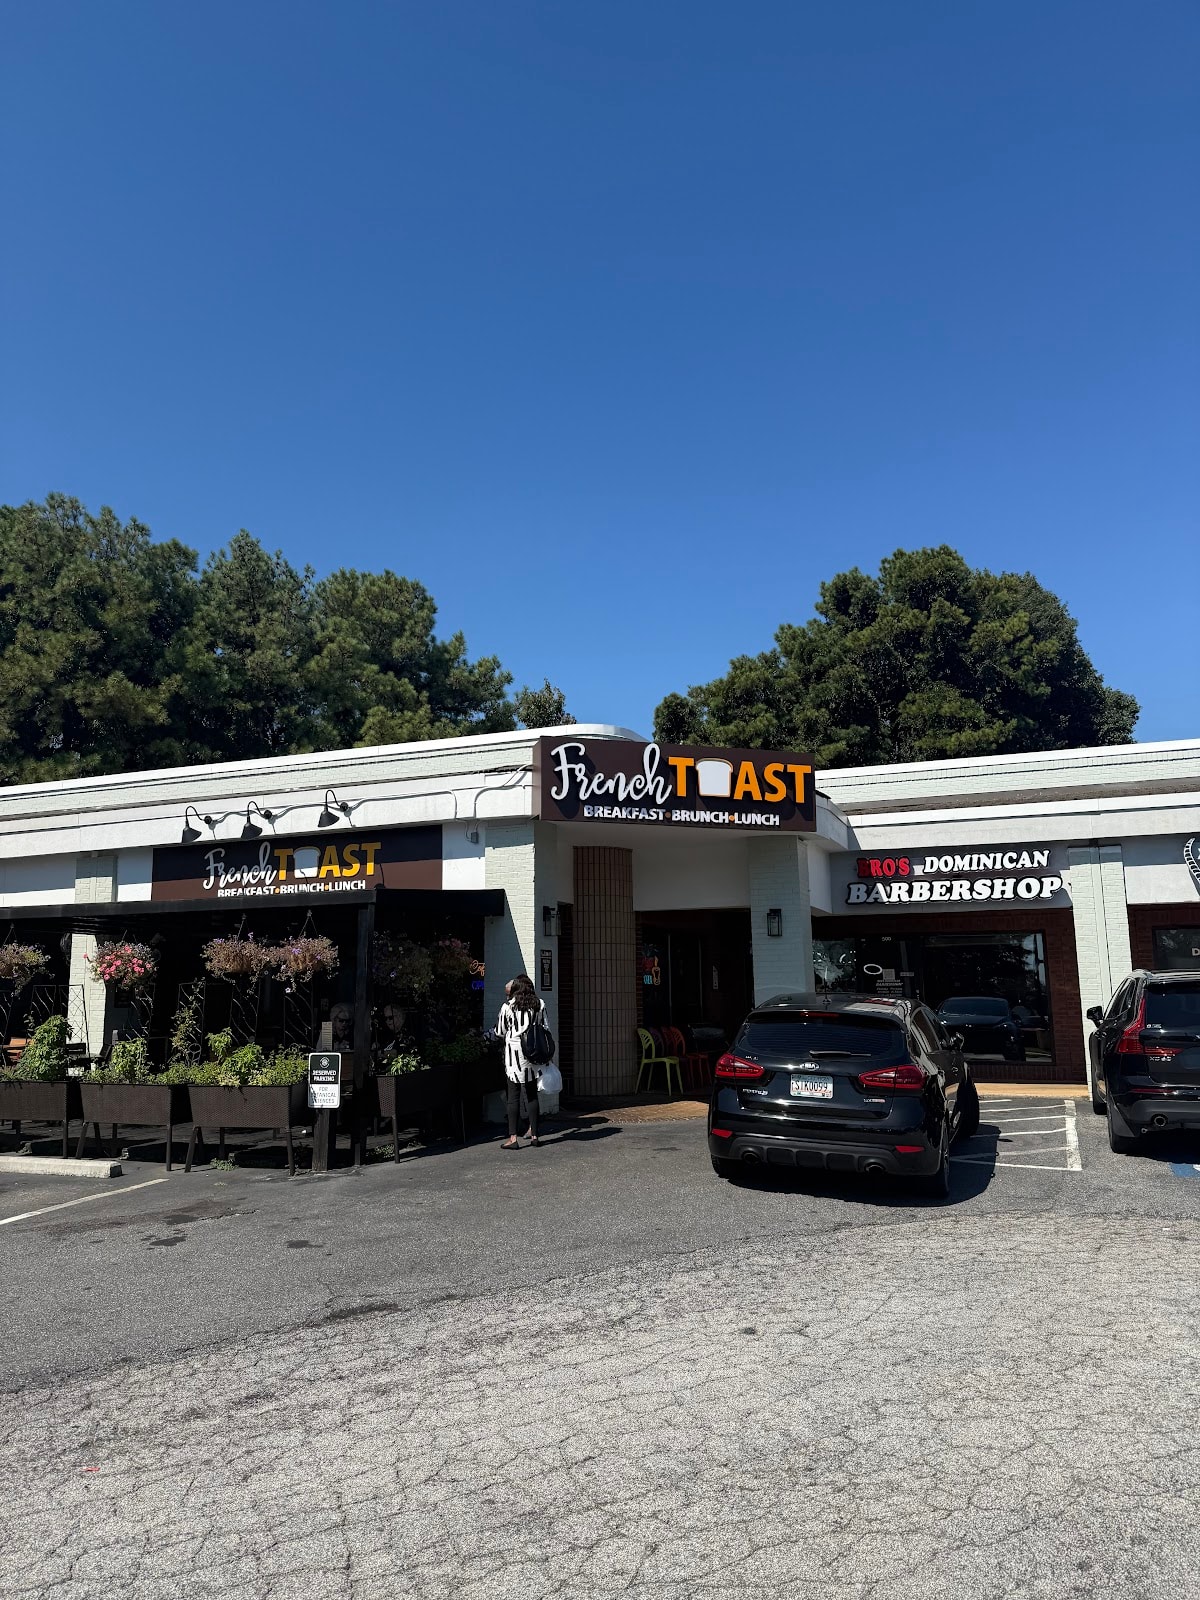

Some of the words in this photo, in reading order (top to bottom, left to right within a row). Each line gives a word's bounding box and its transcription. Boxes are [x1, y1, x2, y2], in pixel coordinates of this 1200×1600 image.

[550, 742, 672, 804] French
[584, 805, 665, 821] BREAKFAST
[671, 811, 729, 824] BRUNCH
[734, 813, 780, 826] LUNCH
[203, 841, 278, 890] French
[856, 857, 910, 878] BRO'S
[923, 850, 1050, 873] DOMINICAN
[217, 885, 276, 897] BREAKFAST
[280, 882, 324, 894] BRUNCH
[329, 880, 366, 891] LUNCH
[847, 875, 1064, 905] BARBERSHOP
